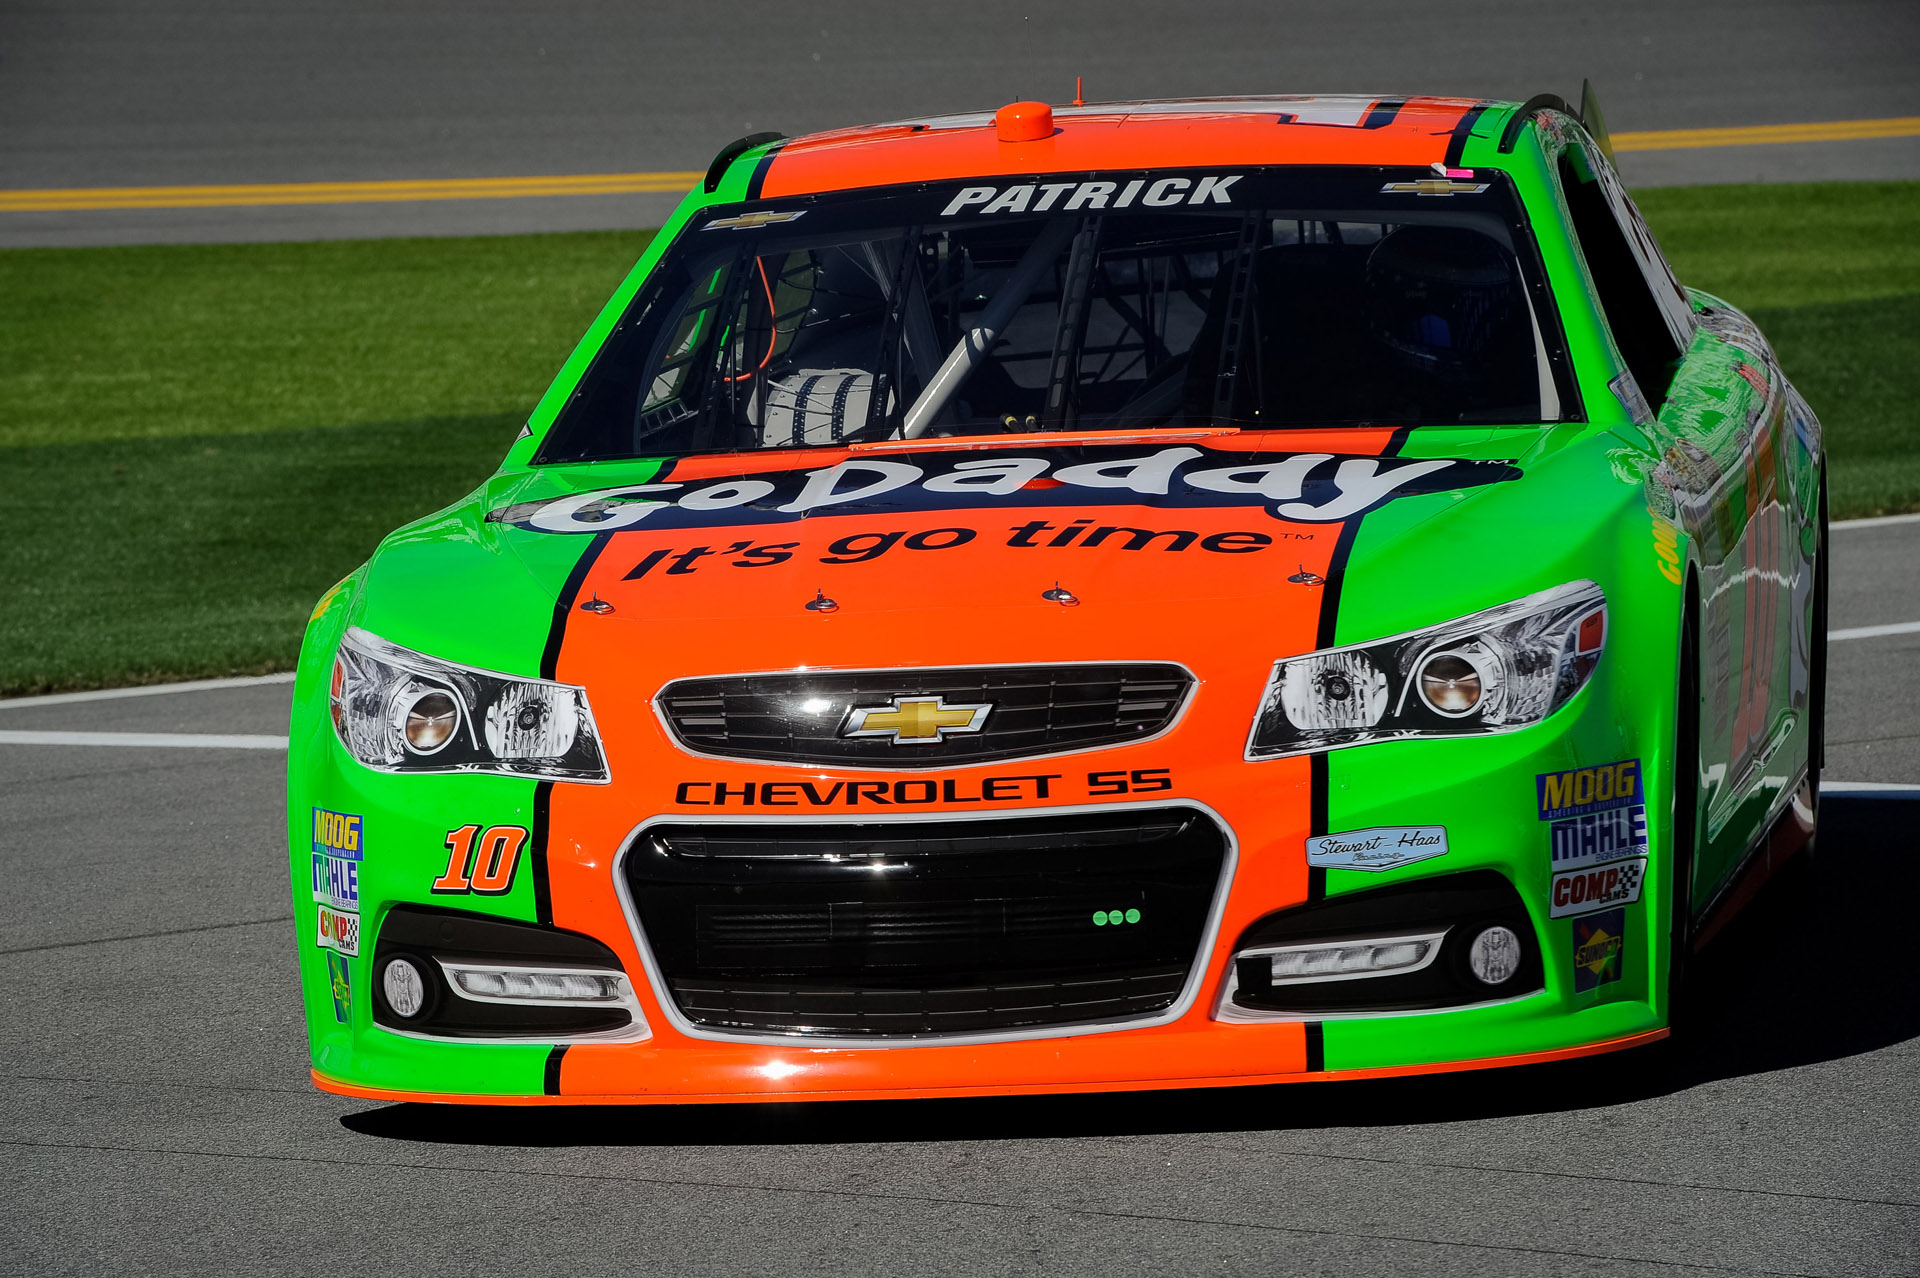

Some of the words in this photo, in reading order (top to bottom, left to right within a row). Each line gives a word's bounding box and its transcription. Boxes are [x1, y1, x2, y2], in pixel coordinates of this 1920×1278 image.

[940, 175, 1243, 216] PATRICK
[529, 447, 1457, 521] GoDaddy
[620, 540, 801, 582] It's
[818, 527, 978, 565] go
[1005, 519, 1274, 554] time
[675, 774, 1063, 806] CHEVROLET
[1087, 768, 1173, 797] SS
[1542, 761, 1636, 812] MOOG
[314, 809, 360, 851] MOOG
[1311, 836, 1389, 856] Stewart
[1397, 831, 1441, 848] Haas
[1551, 805, 1647, 862] MAHLE
[430, 824, 530, 897] 10
[1554, 868, 1619, 908] COMP
[1599, 888, 1630, 904] CAMS
[338, 938, 355, 951] CAMS
